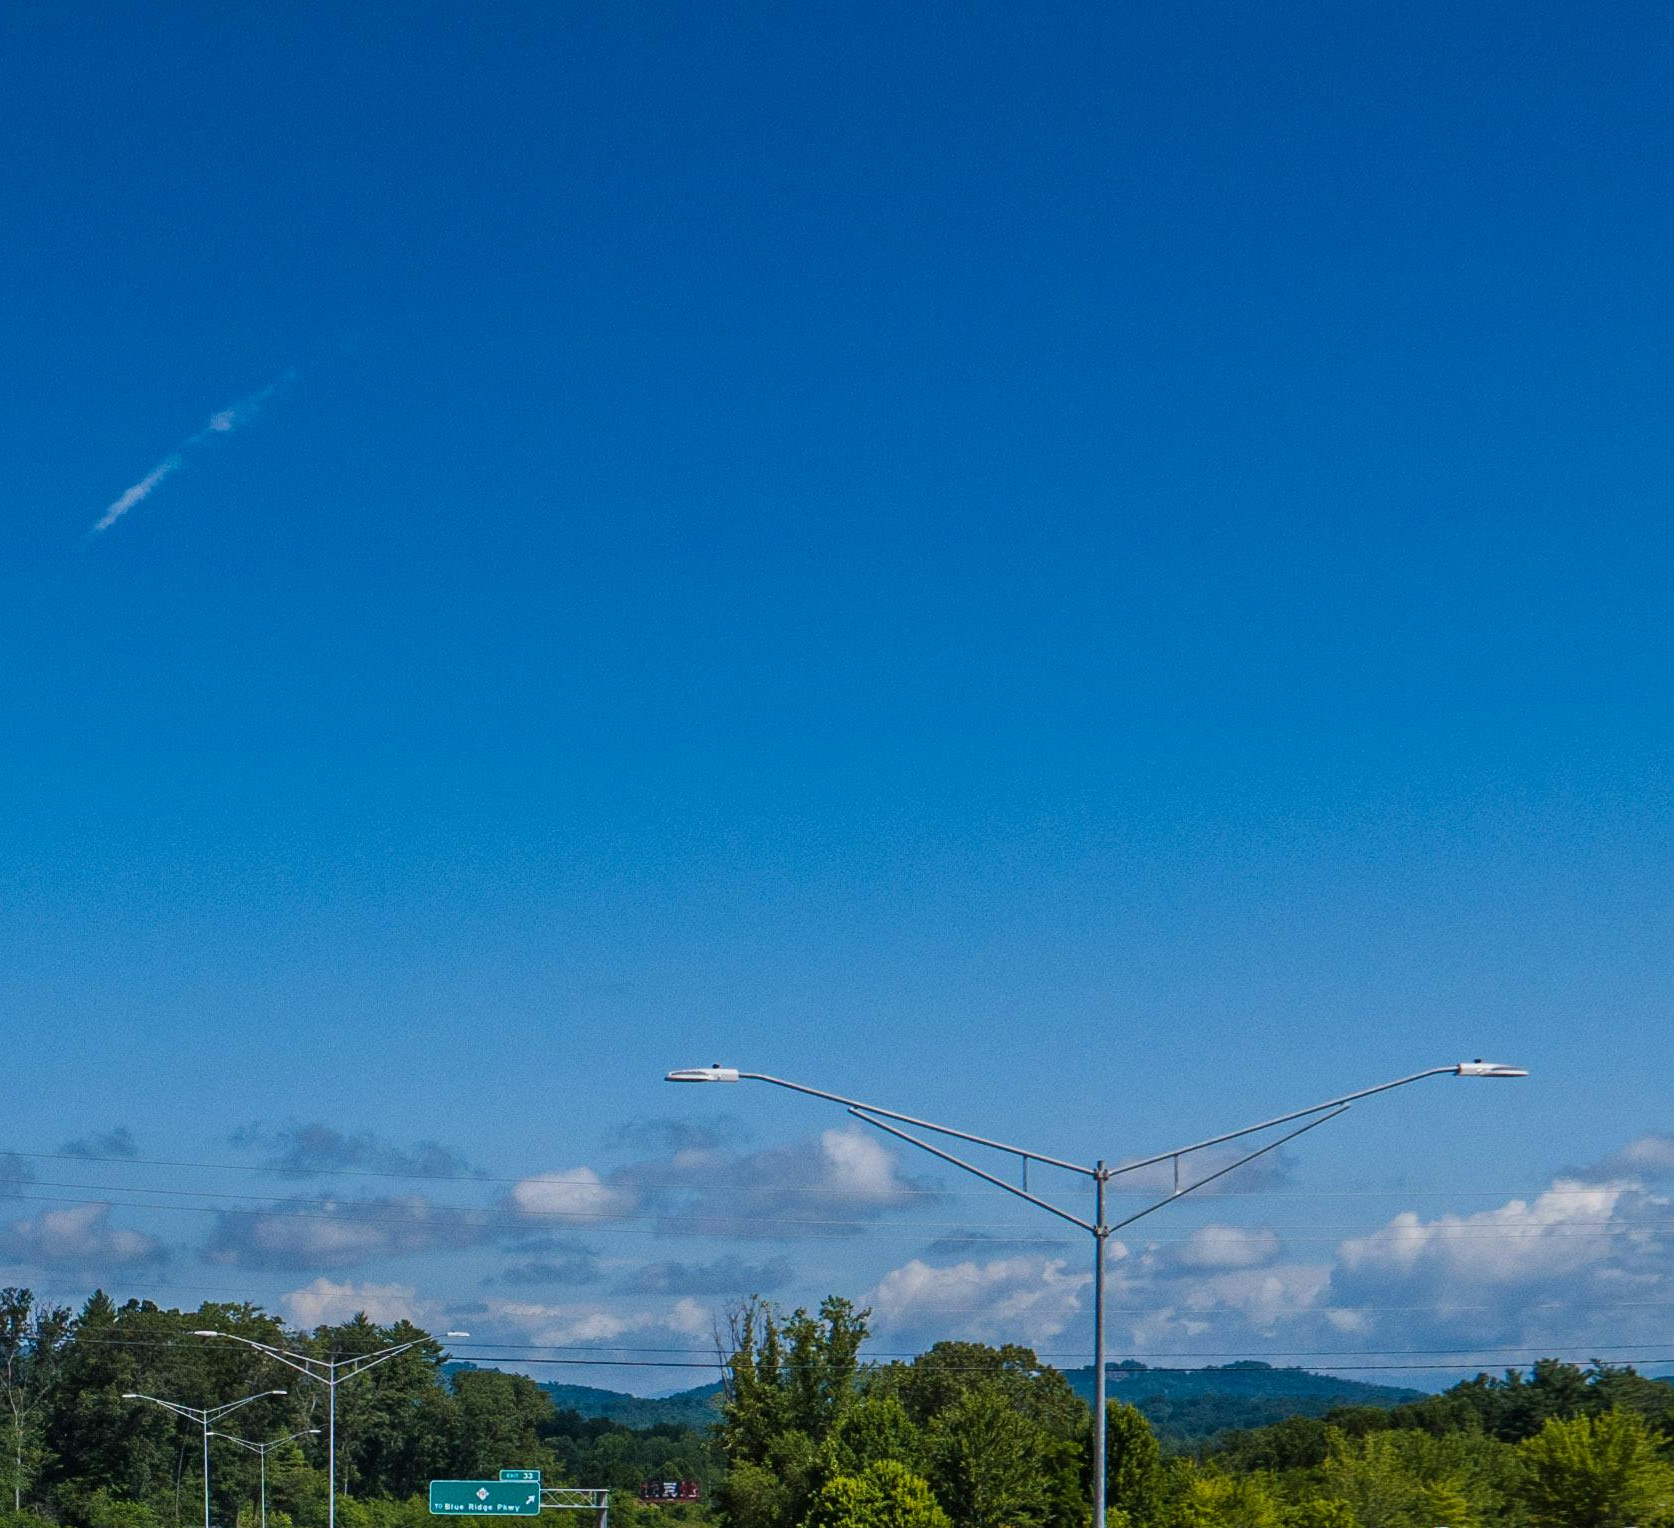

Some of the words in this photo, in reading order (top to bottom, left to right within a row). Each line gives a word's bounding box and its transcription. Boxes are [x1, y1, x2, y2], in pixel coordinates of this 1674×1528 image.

[523, 1472, 534, 1480] 33
[444, 1503, 464, 1511] Blue
[468, 1503, 493, 1512] Ridge
[497, 1503, 520, 1513] Pkwy
